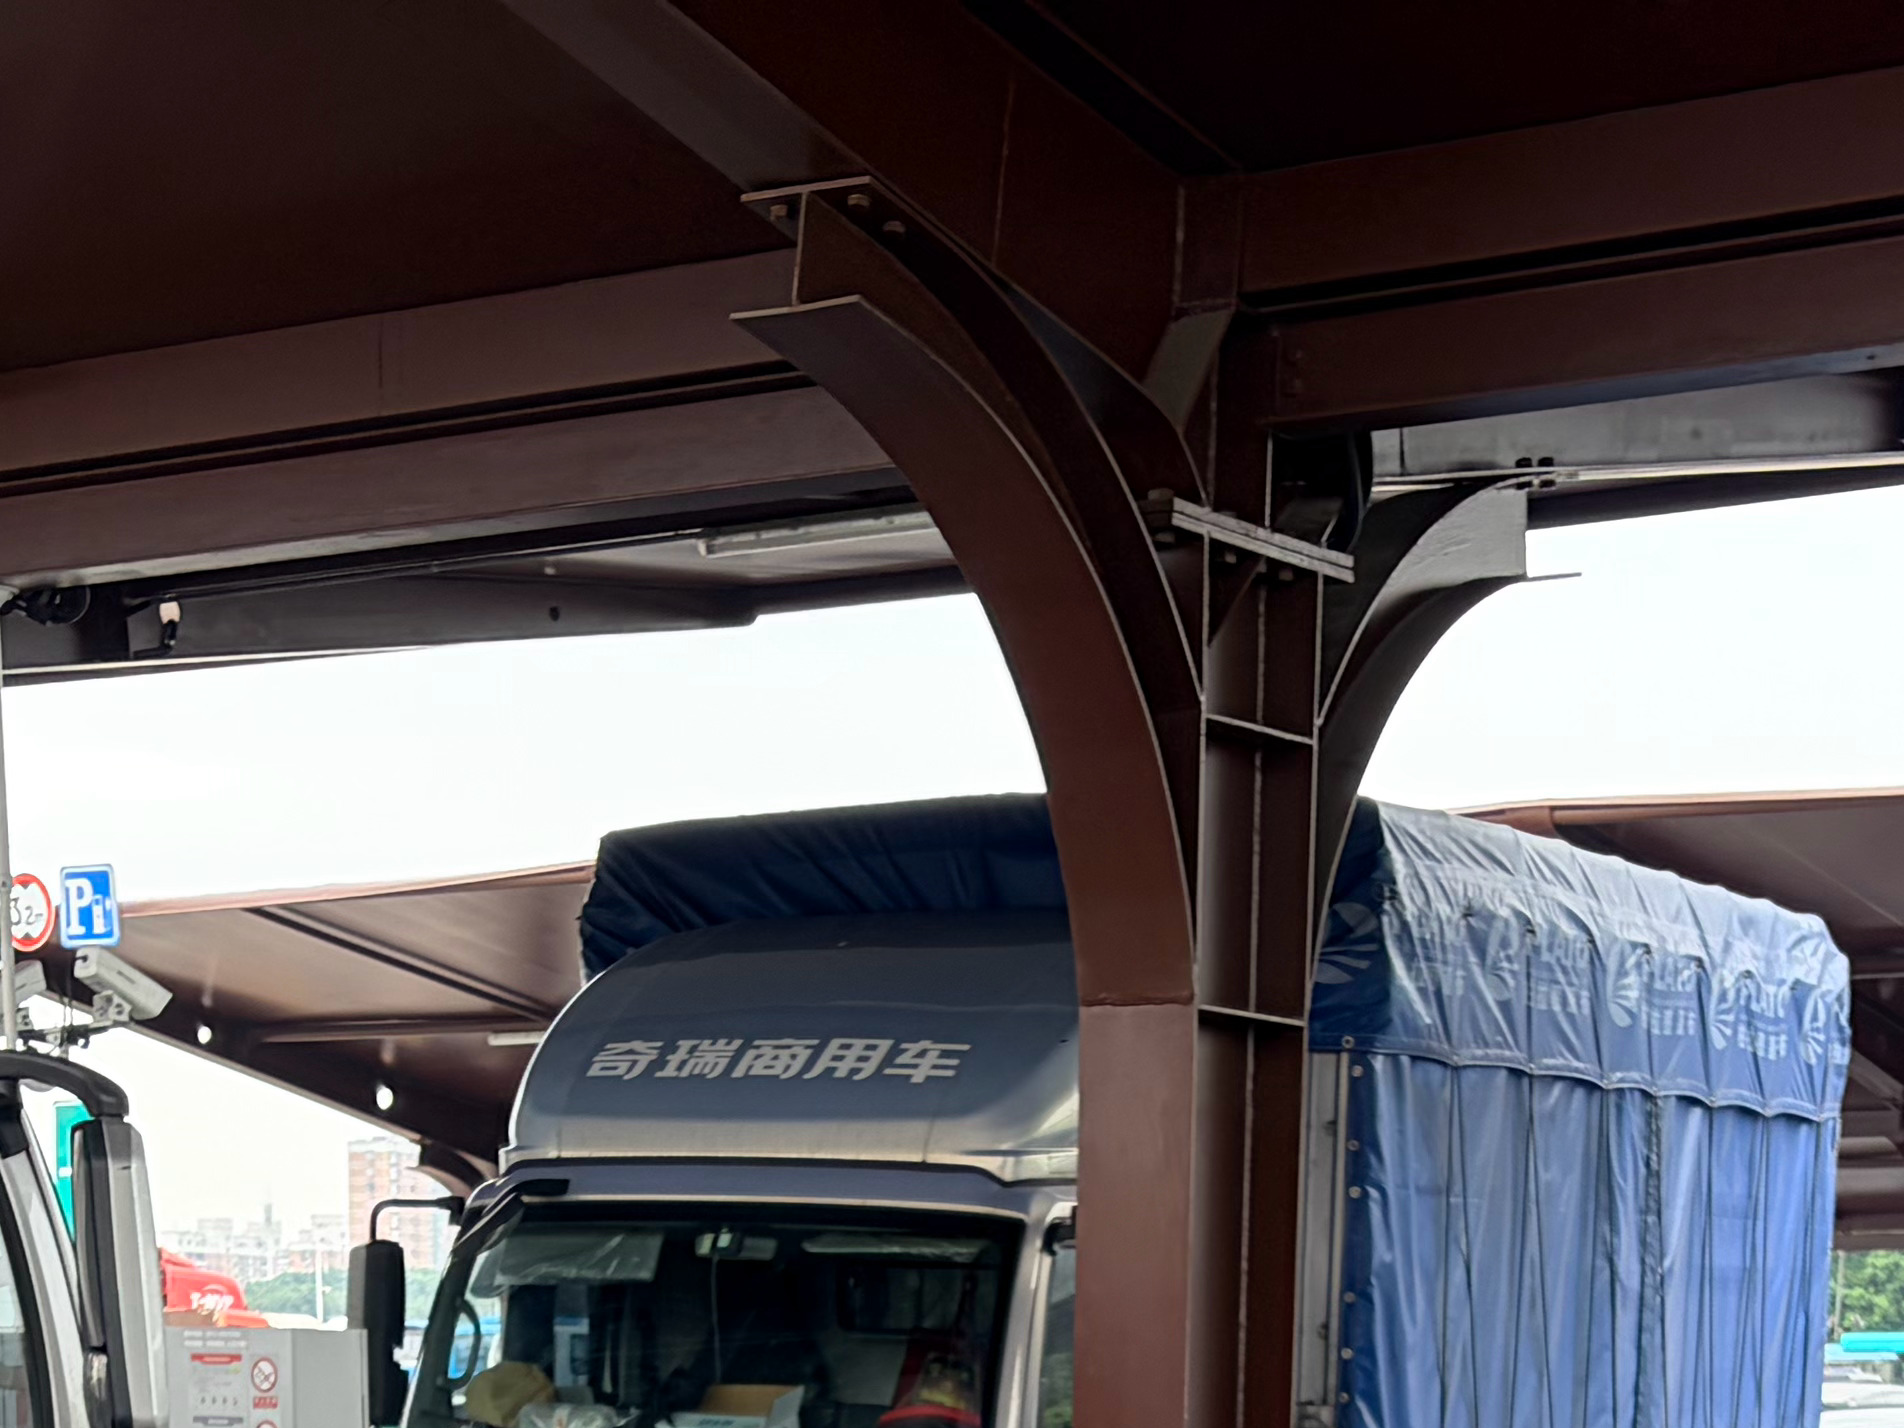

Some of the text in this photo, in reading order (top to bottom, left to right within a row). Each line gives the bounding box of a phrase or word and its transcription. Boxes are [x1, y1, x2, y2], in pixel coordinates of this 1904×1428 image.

[586, 1037, 971, 1084] 奇瑞商用车
